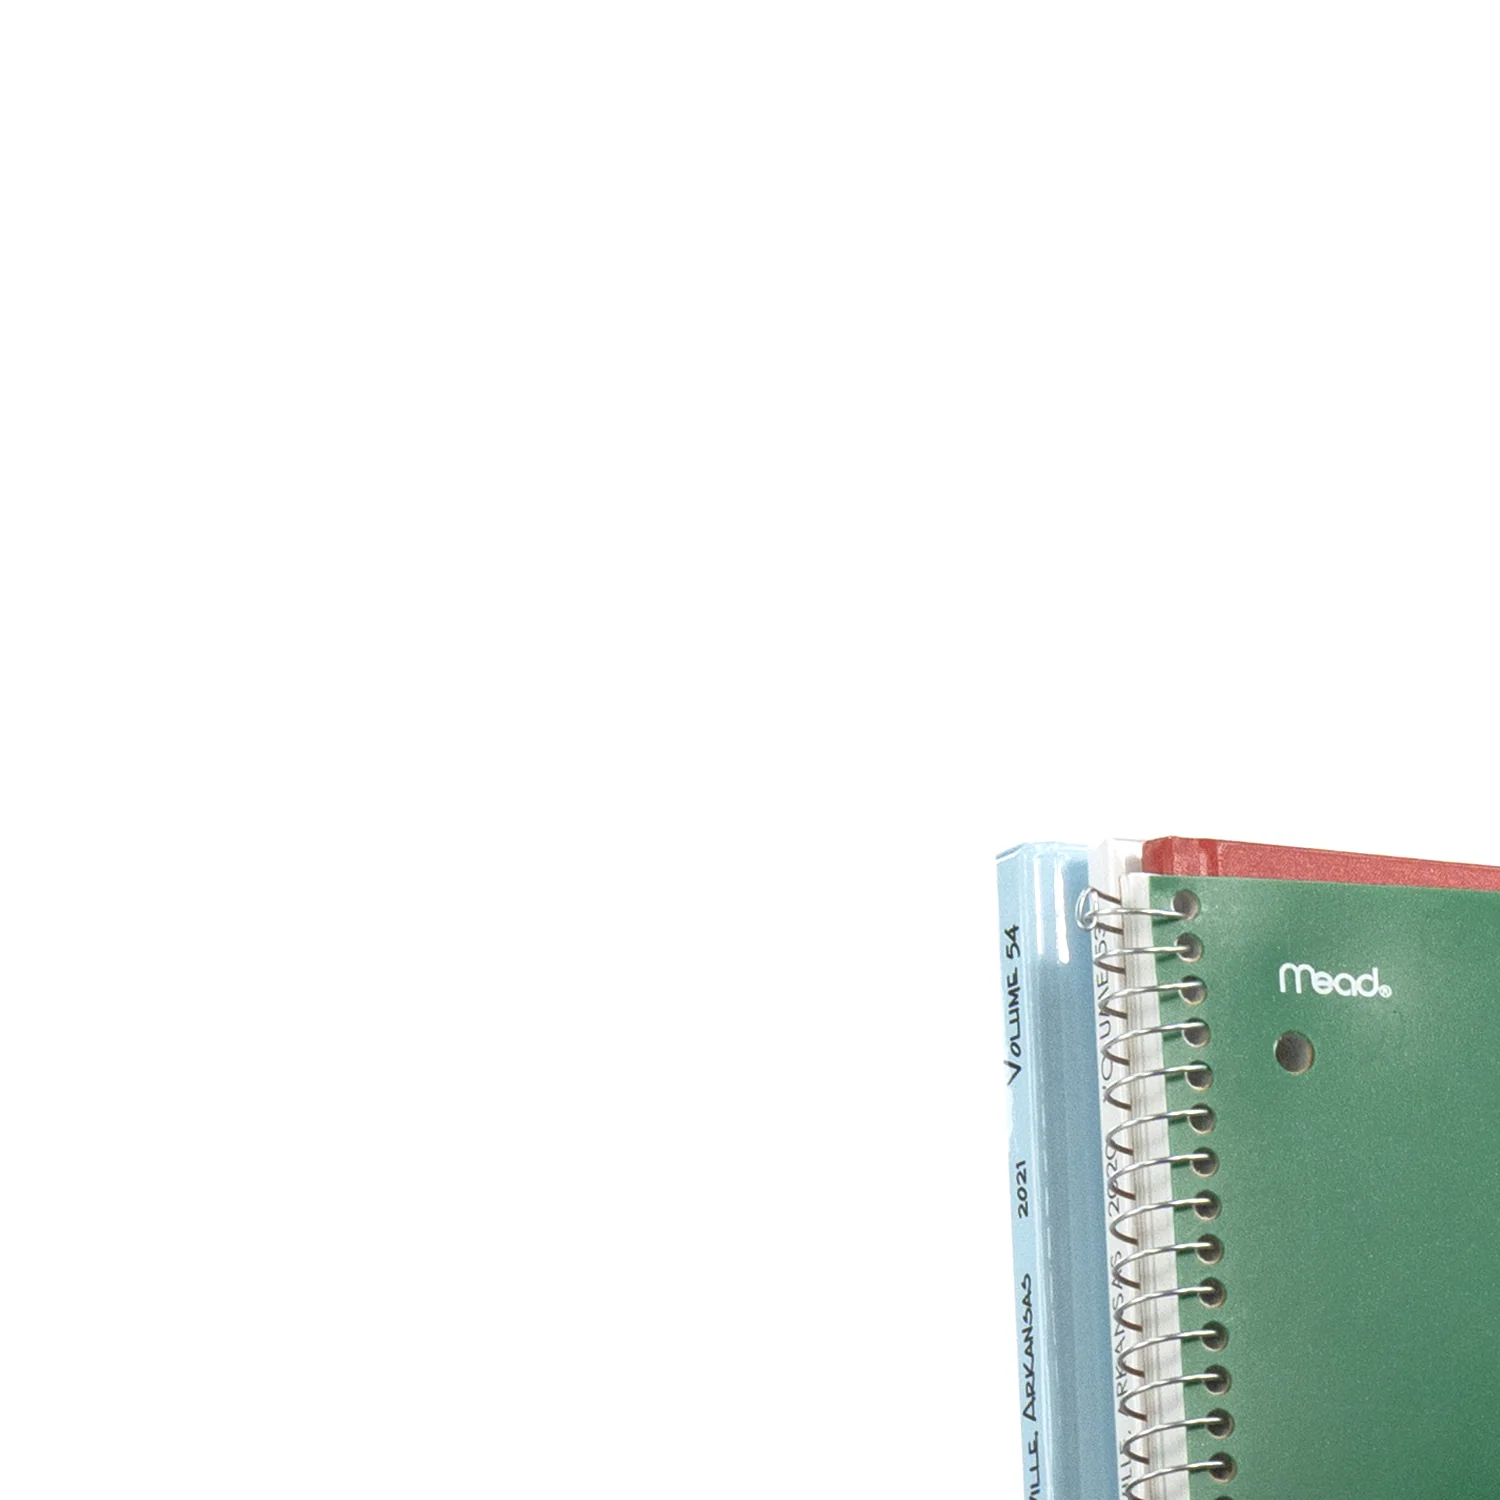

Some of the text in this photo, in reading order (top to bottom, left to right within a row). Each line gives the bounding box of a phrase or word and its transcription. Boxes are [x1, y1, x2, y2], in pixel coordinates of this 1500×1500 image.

[1005, 924, 1019, 958] 54
[1003, 967, 1021, 1086] VOLUME
[1015, 1160, 1029, 1218] 2021
[1022, 1273, 1037, 1421] ARKANSAS
